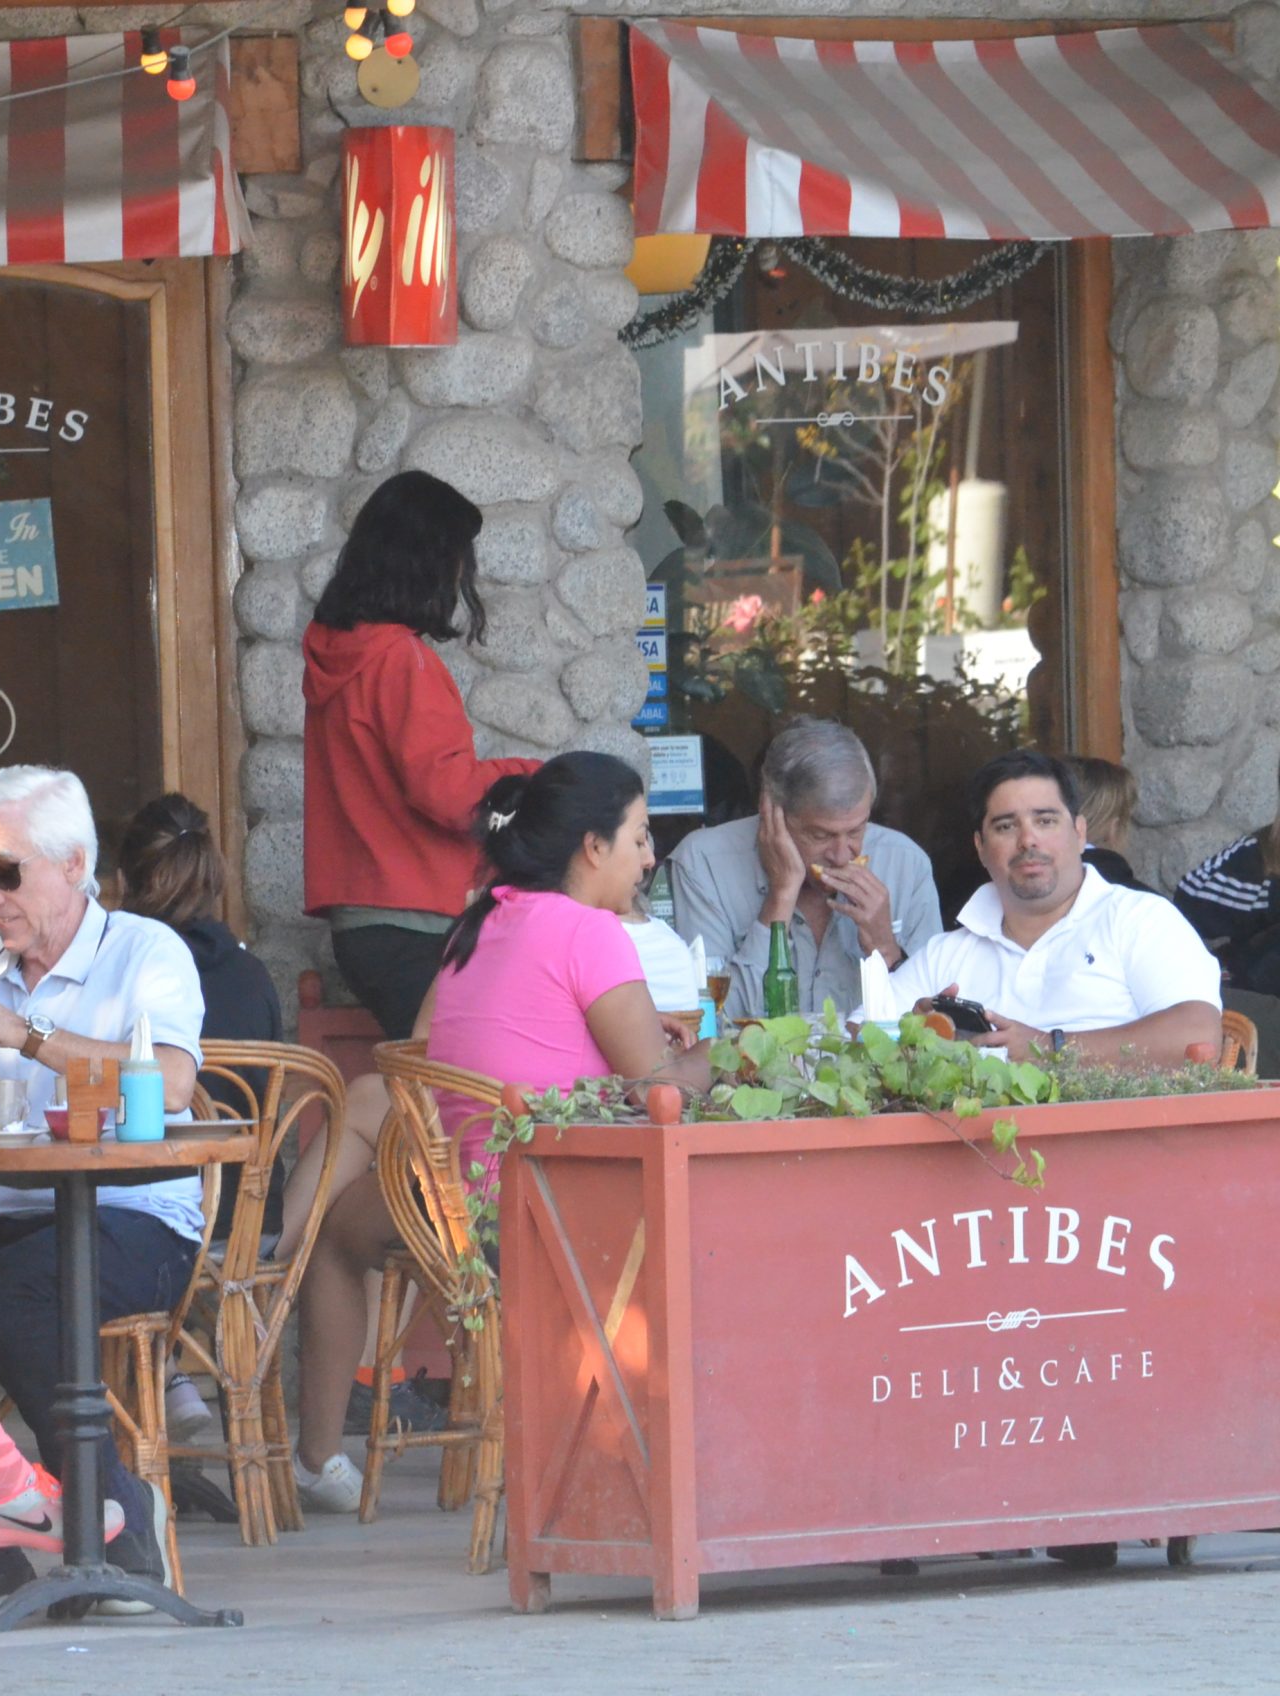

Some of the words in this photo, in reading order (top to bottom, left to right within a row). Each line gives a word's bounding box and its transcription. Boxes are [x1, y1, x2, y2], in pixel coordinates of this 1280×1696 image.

[345, 152, 385, 318] lly
[719, 341, 950, 411] ANTIBES
[5, 512, 39, 544] In
[843, 1206, 1175, 1318] ANTIBES
[954, 1415, 1076, 1449] PIZZA
